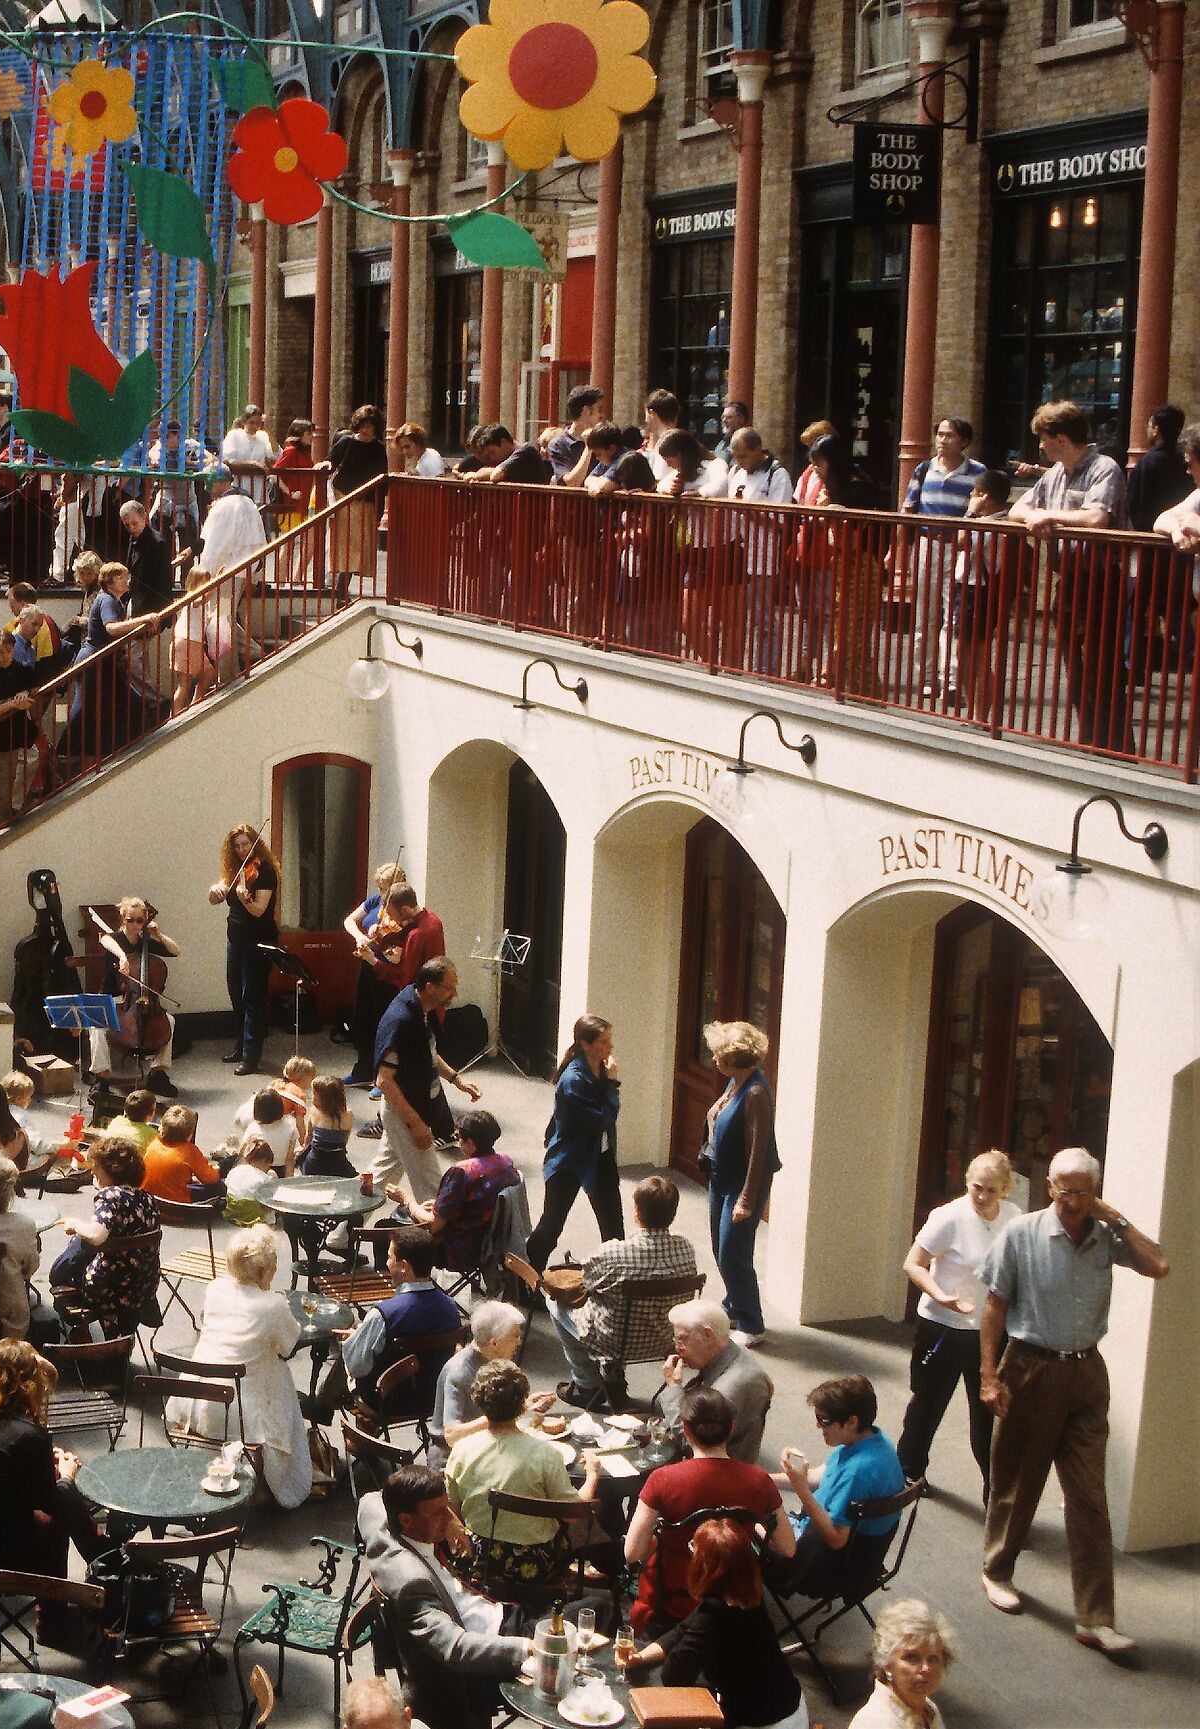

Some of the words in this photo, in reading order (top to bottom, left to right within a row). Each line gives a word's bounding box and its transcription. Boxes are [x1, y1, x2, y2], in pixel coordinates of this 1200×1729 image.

[877, 133, 917, 149] THE
[870, 152, 924, 170] BODY
[1018, 160, 1055, 187] THE
[1058, 152, 1109, 181] BODY
[1109, 145, 1148, 173] SHO
[869, 173, 923, 191] SHOP
[668, 216, 692, 235] THE
[693, 211, 724, 232] BODY
[724, 208, 736, 227] SH
[446, 390, 467, 405] SLE
[629, 750, 675, 789] PAST
[878, 829, 946, 876] PAST
[954, 832, 1053, 921] TIMES
